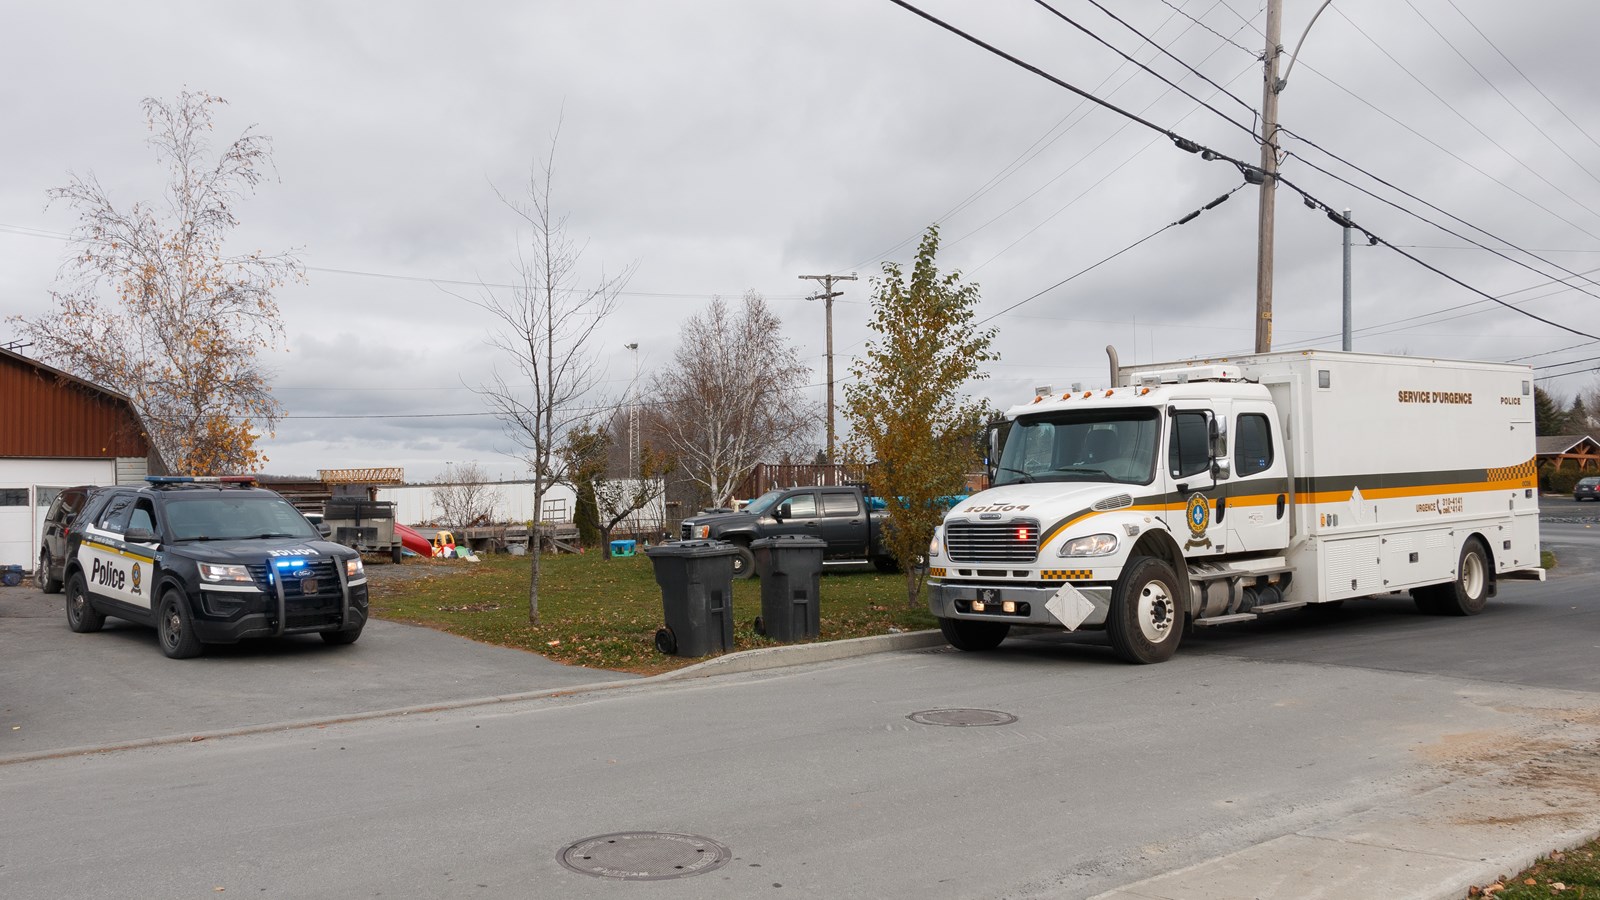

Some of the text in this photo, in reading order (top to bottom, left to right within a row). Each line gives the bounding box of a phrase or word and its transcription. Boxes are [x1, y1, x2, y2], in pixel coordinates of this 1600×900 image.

[1398, 390, 1472, 404] SERVICE D'URGENCE
[1501, 397, 1521, 405] POLICE
[1442, 497, 1463, 506] 310-4141
[1416, 503, 1436, 512] URGENCE
[91, 557, 125, 590] Police
